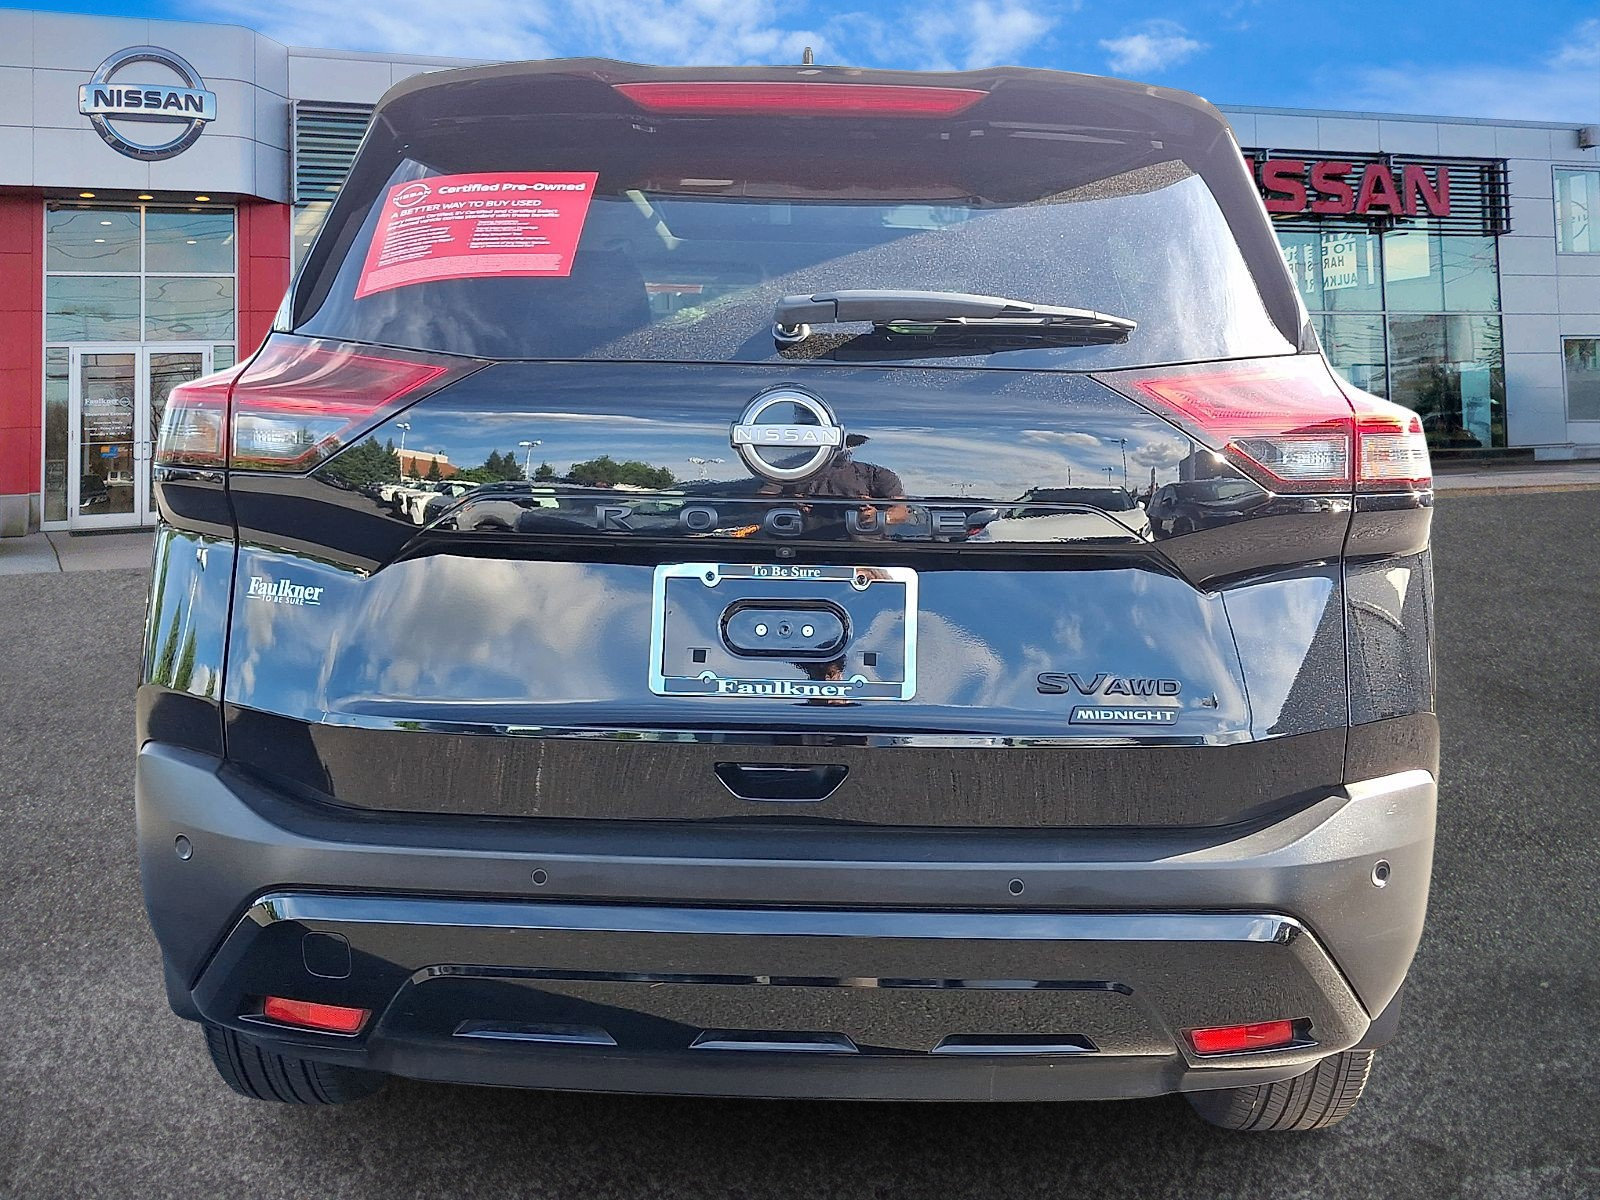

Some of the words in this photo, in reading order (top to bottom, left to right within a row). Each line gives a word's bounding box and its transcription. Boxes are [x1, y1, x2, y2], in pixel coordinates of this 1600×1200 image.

[93, 89, 204, 113] NISSAN
[392, 189, 432, 202] NISSAN
[438, 183, 500, 195] Certified
[501, 183, 586, 191] Pre-Owned
[1244, 157, 1450, 217] SSAN
[390, 211, 399, 219] A
[400, 204, 440, 217] BETTER
[442, 201, 466, 209] WAY
[737, 428, 838, 442] NISSAN
[595, 504, 969, 537] ROGUE
[751, 565, 768, 577] To
[771, 566, 788, 577] Be
[790, 566, 821, 578] Sure
[247, 576, 324, 601] Faulkner
[715, 679, 853, 697] Faulkner
[1076, 709, 1175, 721] MIDNIGHT
